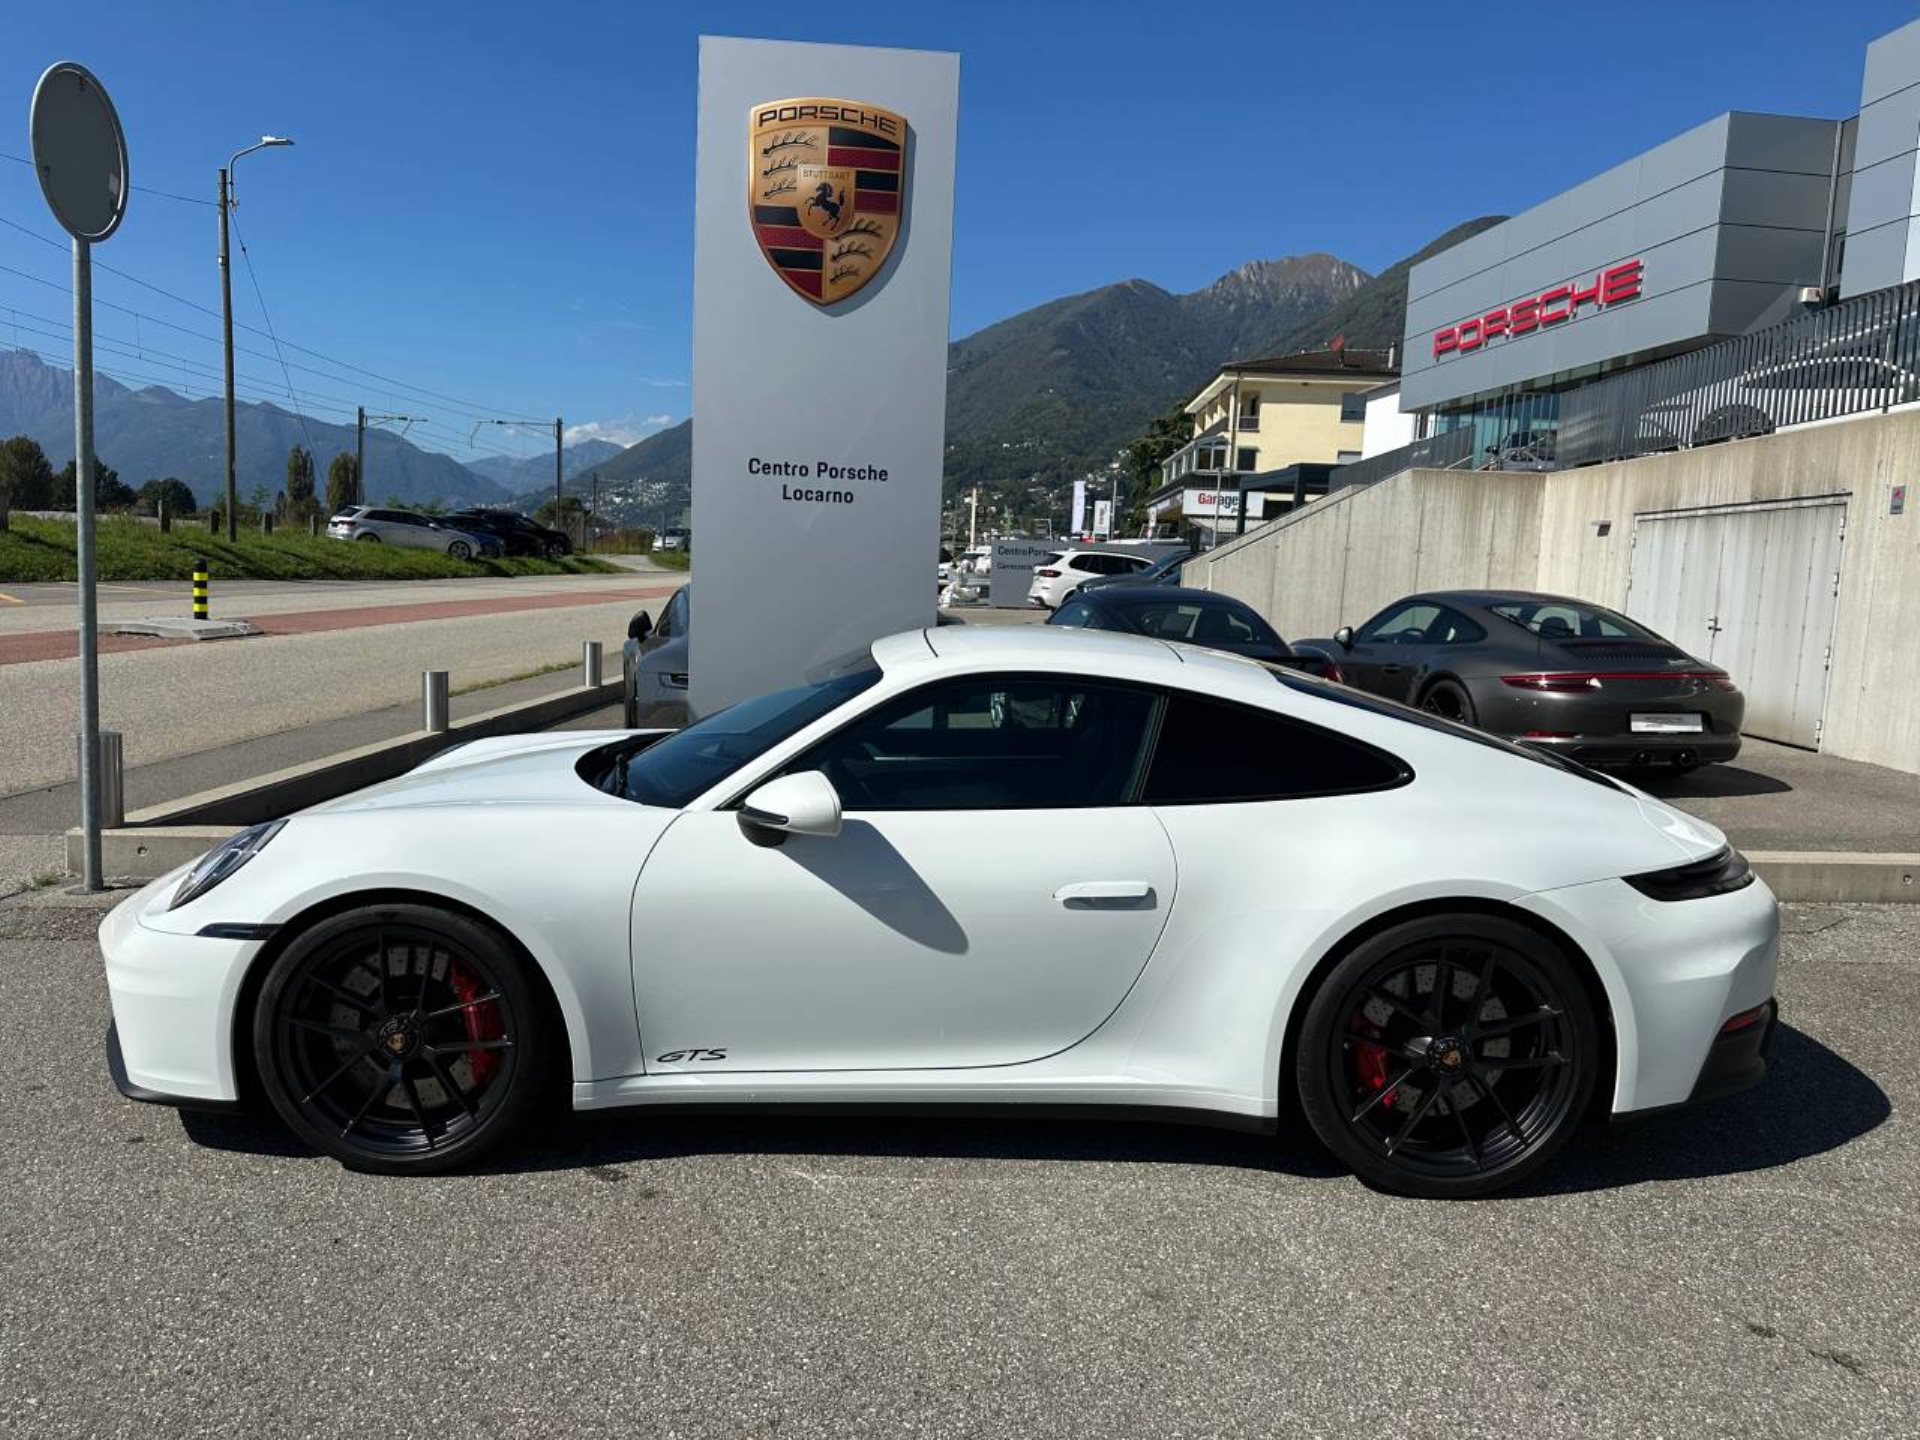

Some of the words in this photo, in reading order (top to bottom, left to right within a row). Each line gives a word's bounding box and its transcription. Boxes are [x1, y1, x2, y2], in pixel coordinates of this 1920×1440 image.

[759, 105, 897, 136] PORSCHE
[1433, 258, 1643, 360] PORSCHE
[748, 457, 809, 477] Centro
[816, 461, 888, 482] Porsche
[782, 484, 854, 504] Locarno
[1198, 492, 1239, 509] Garage
[656, 1048, 727, 1063] GTS
